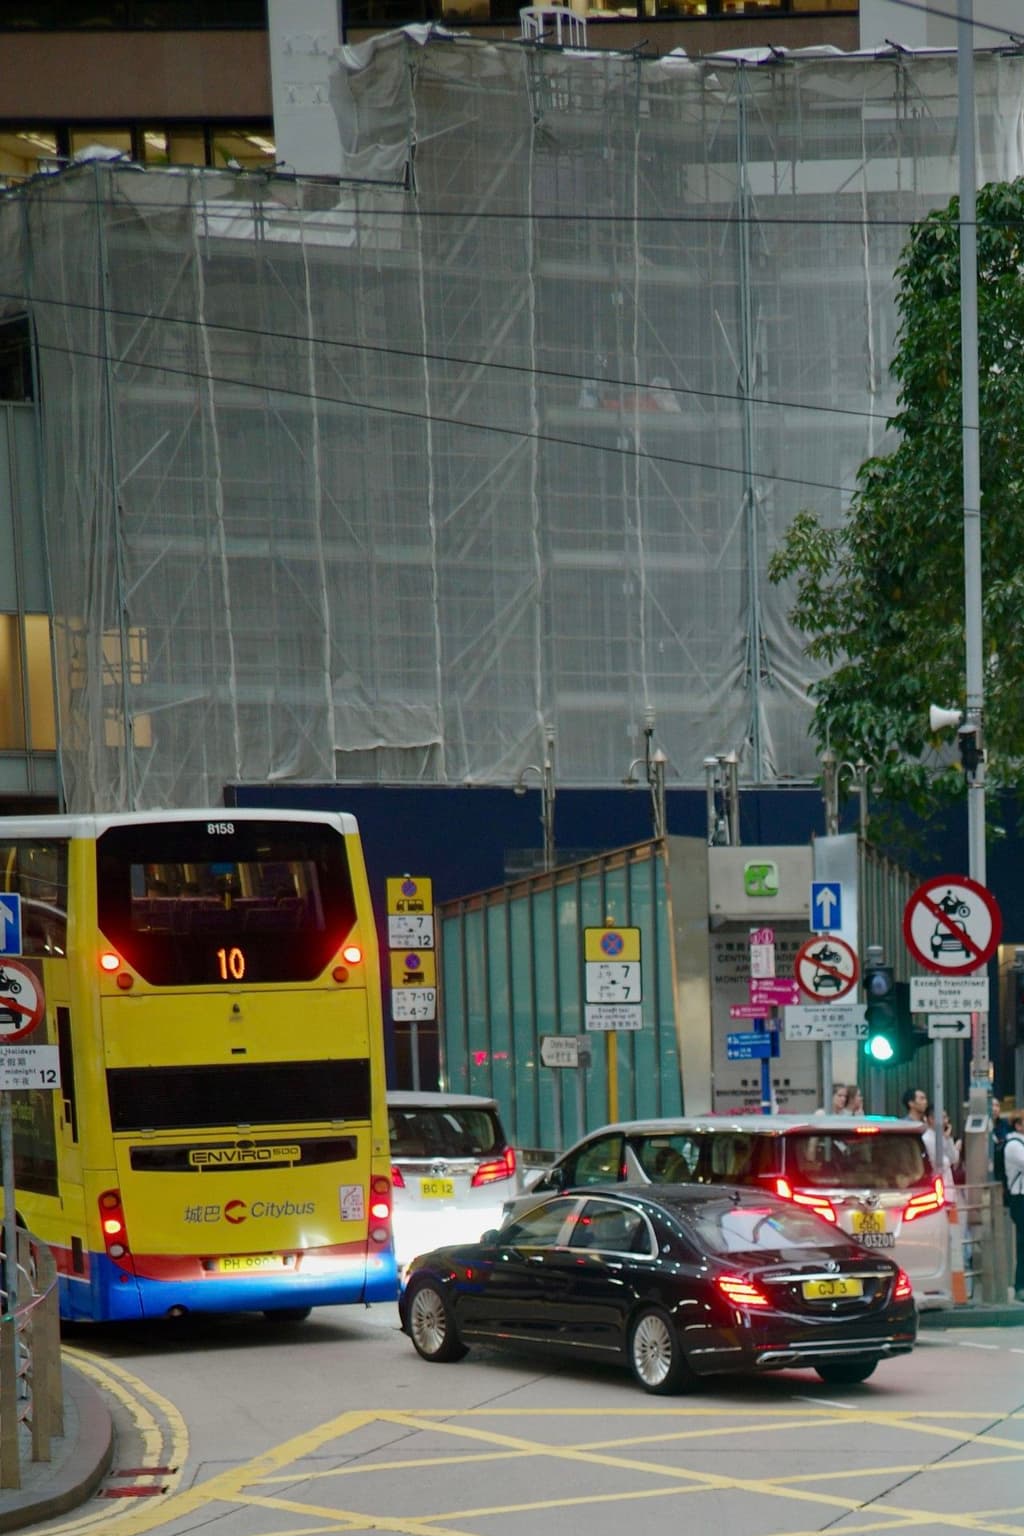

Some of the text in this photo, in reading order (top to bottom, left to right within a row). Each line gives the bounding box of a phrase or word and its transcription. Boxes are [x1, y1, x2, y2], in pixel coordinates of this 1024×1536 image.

[207, 823, 235, 835] 8158
[416, 917, 424, 928] 7
[418, 935, 431, 946] 12
[217, 947, 245, 979] 10
[621, 965, 630, 978] 7
[410, 992, 434, 1002] 7-10
[622, 986, 631, 999] 7
[410, 1007, 428, 1016] 4-7
[805, 1025, 813, 1035] 7
[855, 1024, 869, 1036] 12
[40, 1069, 57, 1084] 12
[184, 1204, 222, 1224] 城巴
[251, 1201, 316, 1219] Citybus
[840, 1283, 848, 1294] 3
